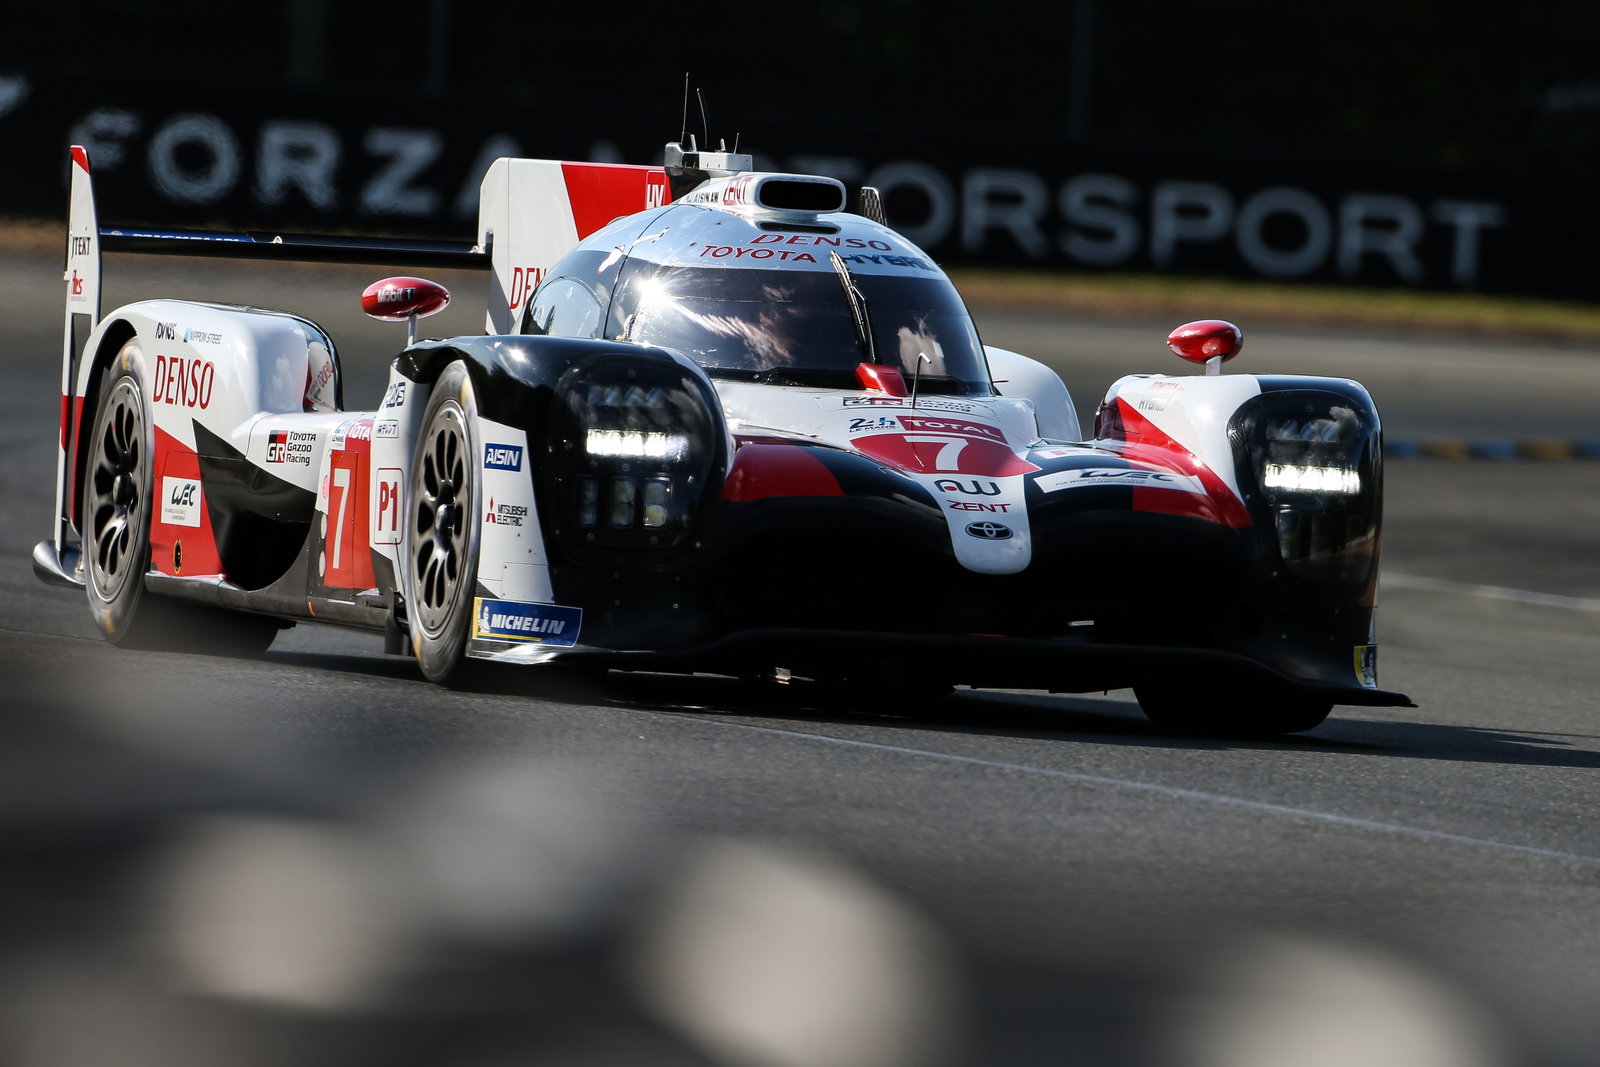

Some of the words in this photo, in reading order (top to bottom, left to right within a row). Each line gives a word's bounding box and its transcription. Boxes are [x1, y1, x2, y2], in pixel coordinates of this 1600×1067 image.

[588, 140, 1507, 289] TORSPORT
[750, 233, 893, 252] DENSO
[700, 245, 818, 263] TOYOTA
[378, 287, 403, 303] Mobil
[152, 354, 214, 410] DENSO
[288, 431, 317, 442] TOYOTA
[903, 419, 1001, 438] TOTAL
[267, 443, 286, 464] GR
[287, 442, 312, 453] GAZOO
[902, 435, 969, 471] 7
[286, 453, 310, 466] Racing
[485, 448, 520, 467] AISIN
[379, 481, 398, 532] P1
[497, 503, 528, 516] MITSUBISHI
[946, 499, 1012, 514] ZENT
[332, 468, 352, 569] 7
[496, 514, 523, 527] ELECTRIC
[490, 613, 566, 635] MICHELIN
